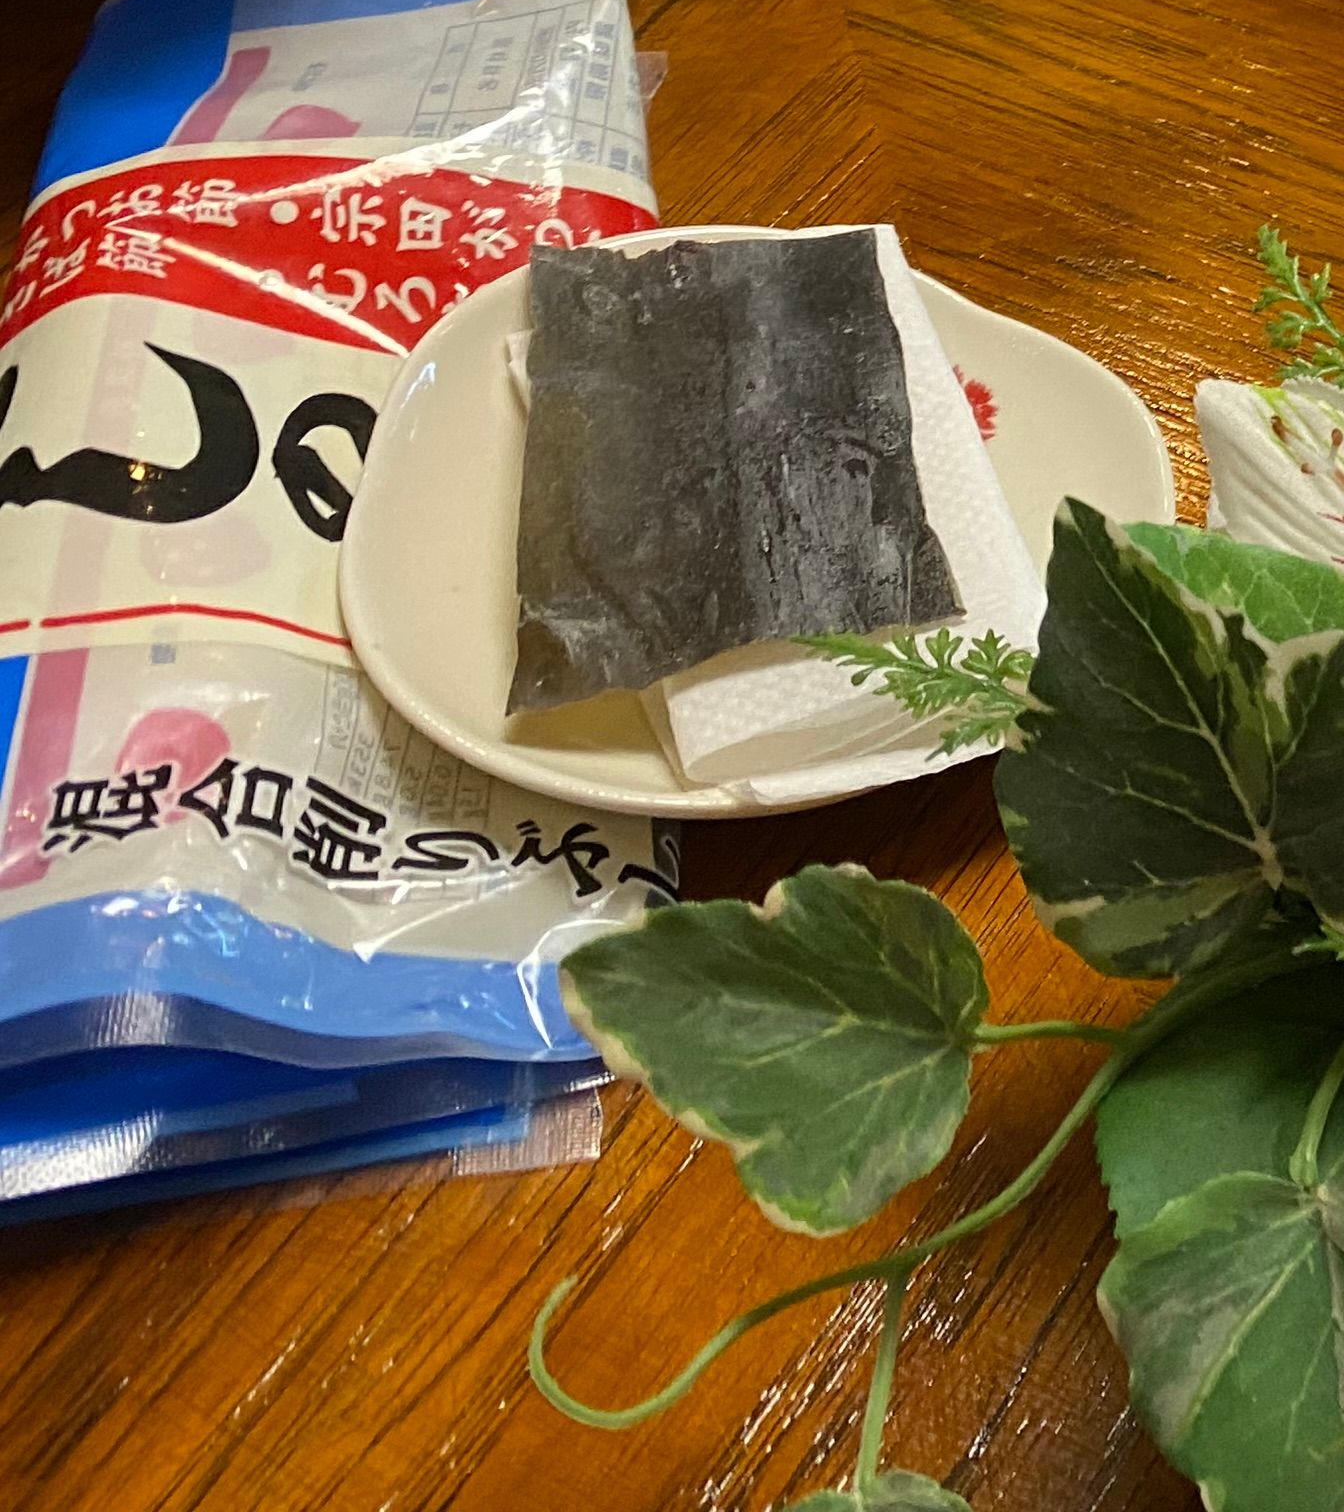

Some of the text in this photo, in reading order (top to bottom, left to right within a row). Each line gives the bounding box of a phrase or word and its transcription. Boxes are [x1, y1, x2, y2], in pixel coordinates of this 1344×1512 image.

[0, 340, 380, 543] しの
[43, 756, 682, 906] 混合削りぶし
